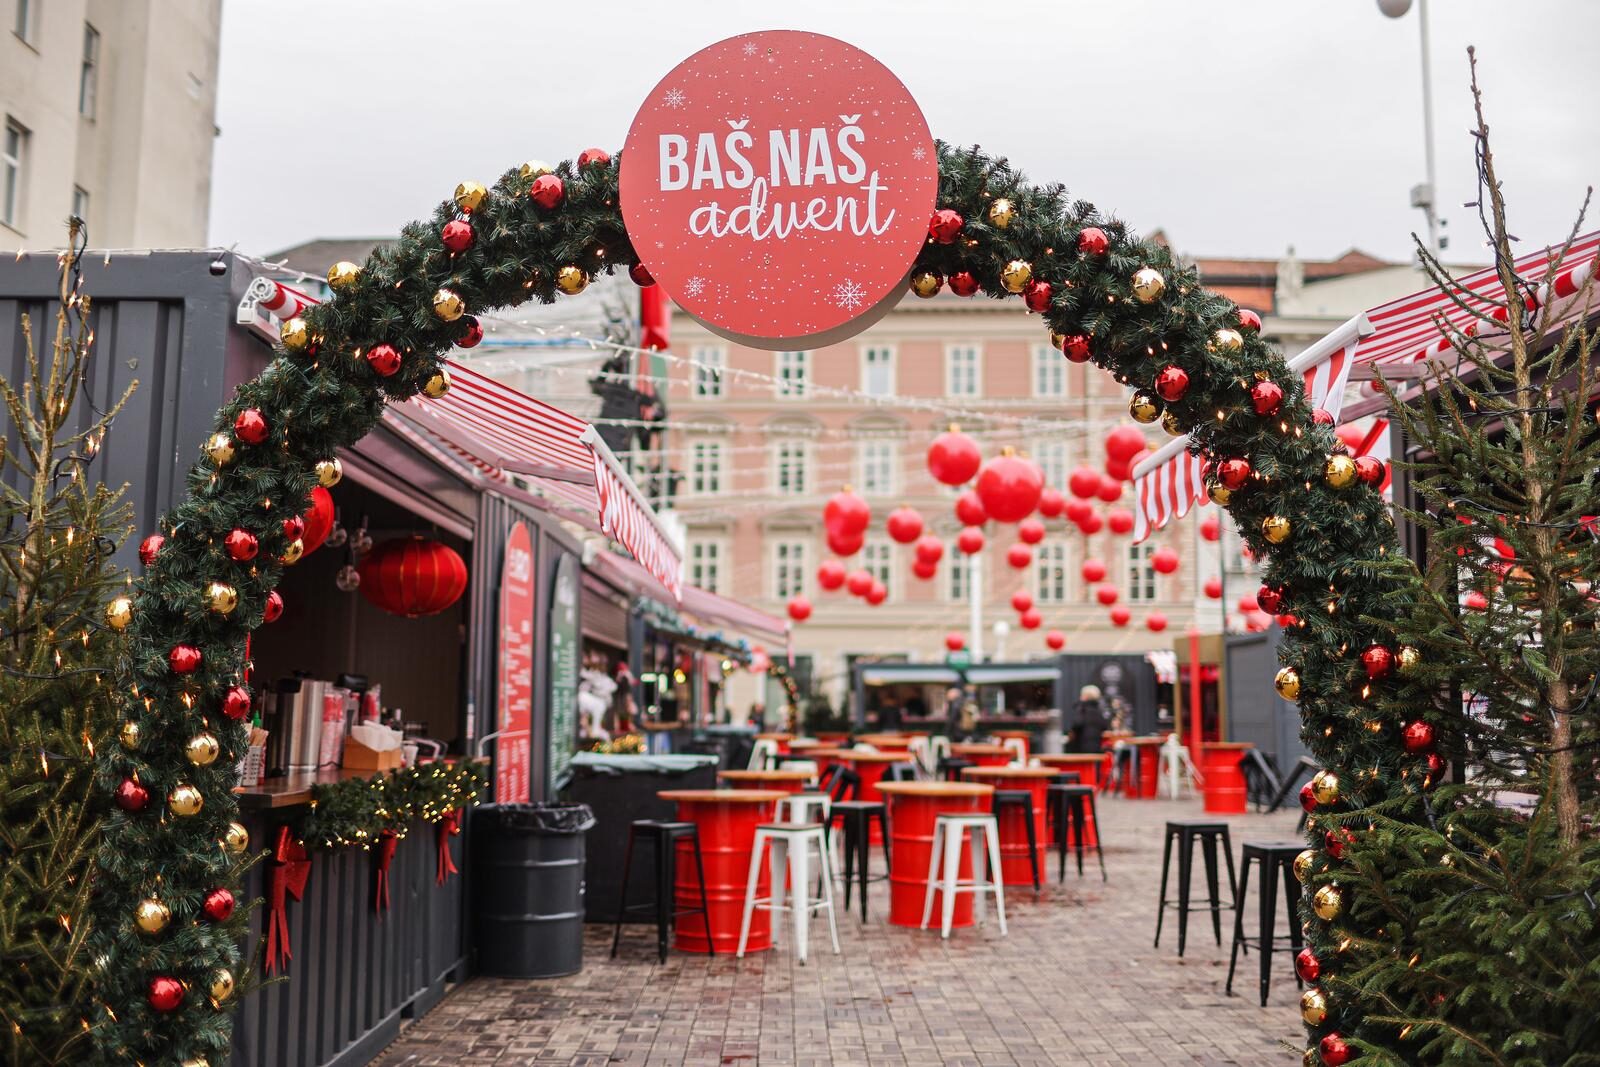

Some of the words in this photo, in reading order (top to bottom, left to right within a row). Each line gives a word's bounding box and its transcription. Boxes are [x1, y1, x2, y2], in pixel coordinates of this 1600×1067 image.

[659, 119, 753, 191] BAŠ
[769, 114, 866, 187] NAŠ
[688, 169, 896, 241] advent
